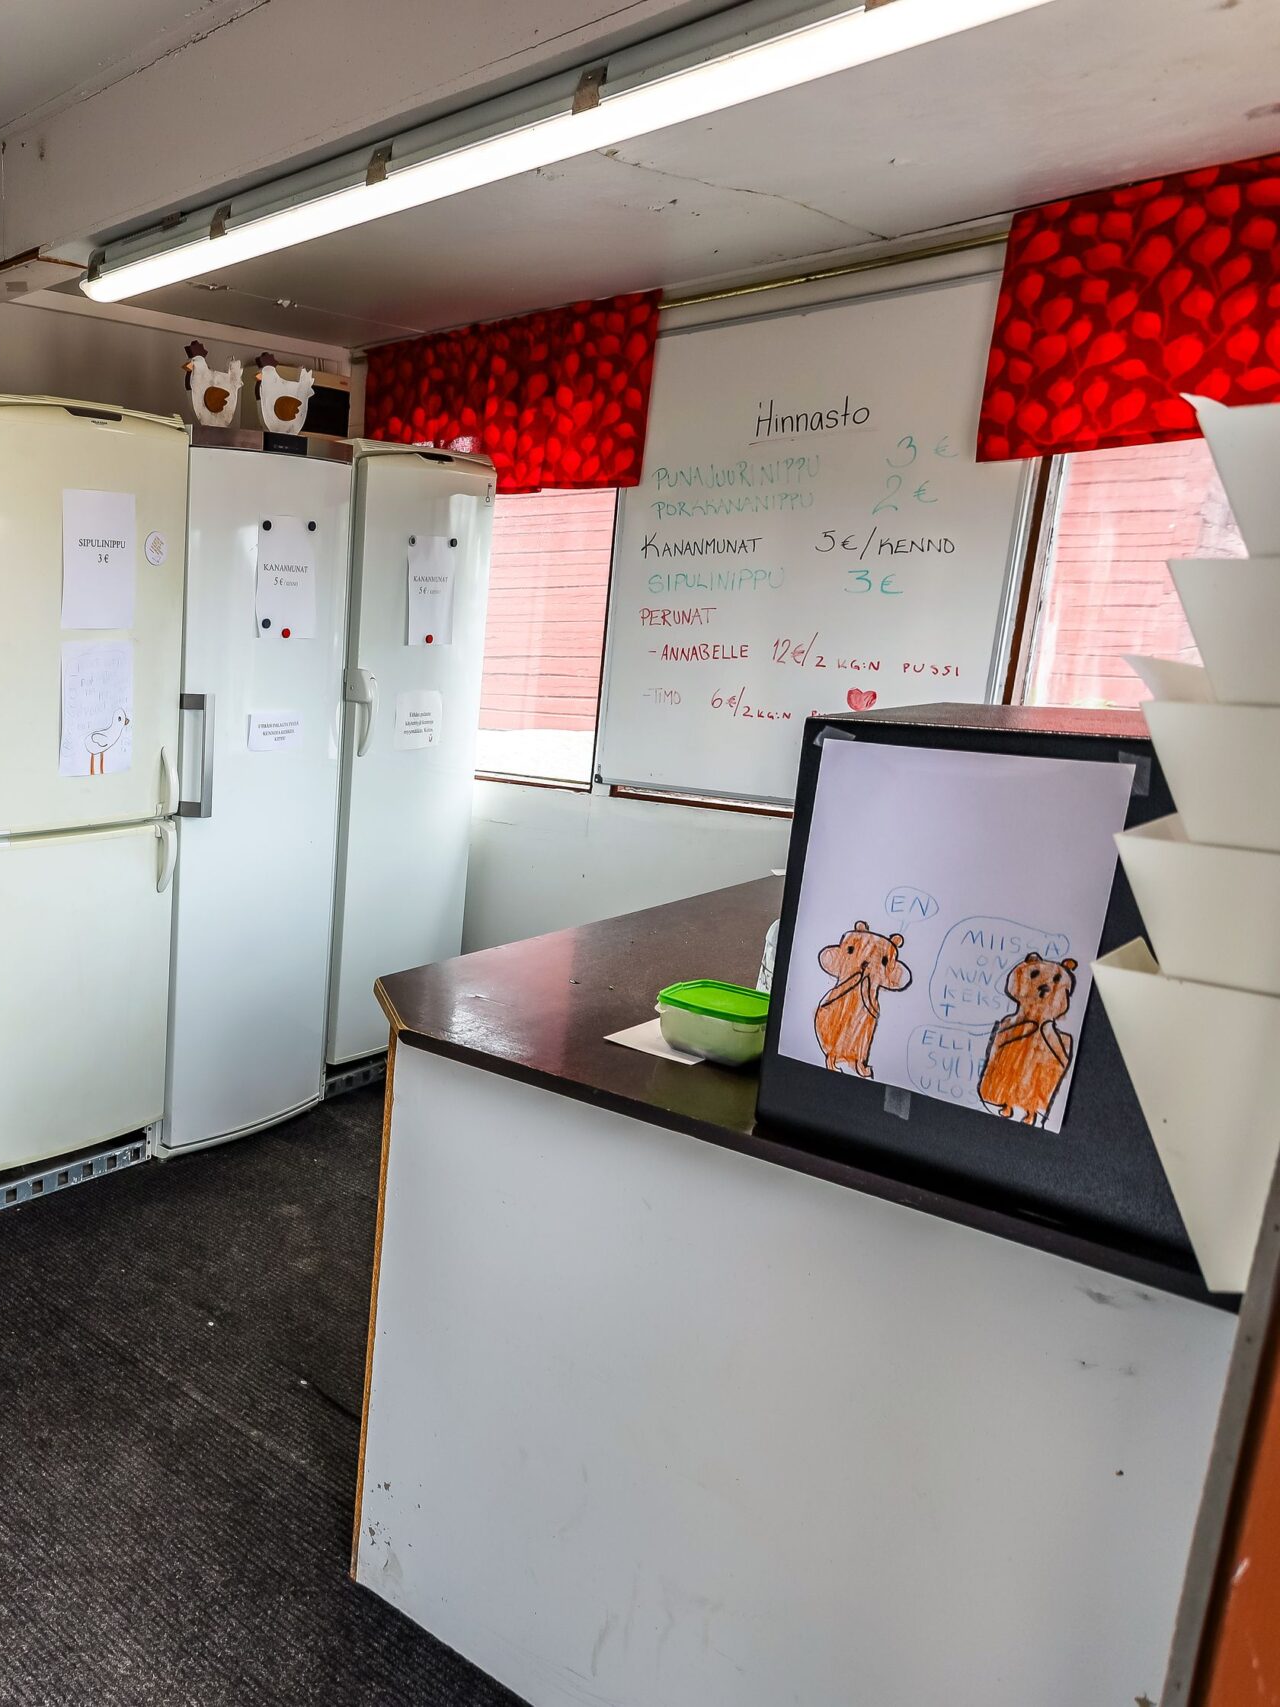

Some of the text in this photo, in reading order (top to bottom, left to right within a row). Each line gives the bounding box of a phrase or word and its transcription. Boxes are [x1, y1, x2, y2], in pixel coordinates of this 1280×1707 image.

[755, 395, 870, 437] Hinnasto
[886, 436, 917, 468] 3
[872, 475, 902, 515] 2
[78, 538, 126, 549] SIPULINIPPU
[641, 533, 763, 557] KANANMUNAT
[263, 564, 309, 573] KANANMUNAT
[648, 567, 785, 593] SIPULINIPPU
[640, 607, 717, 626] PERUNAT
[903, 662, 960, 677] PUSSI
[890, 895, 929, 917] EN
[947, 967, 992, 985] MUN
[922, 1029, 971, 1052] ELLI
